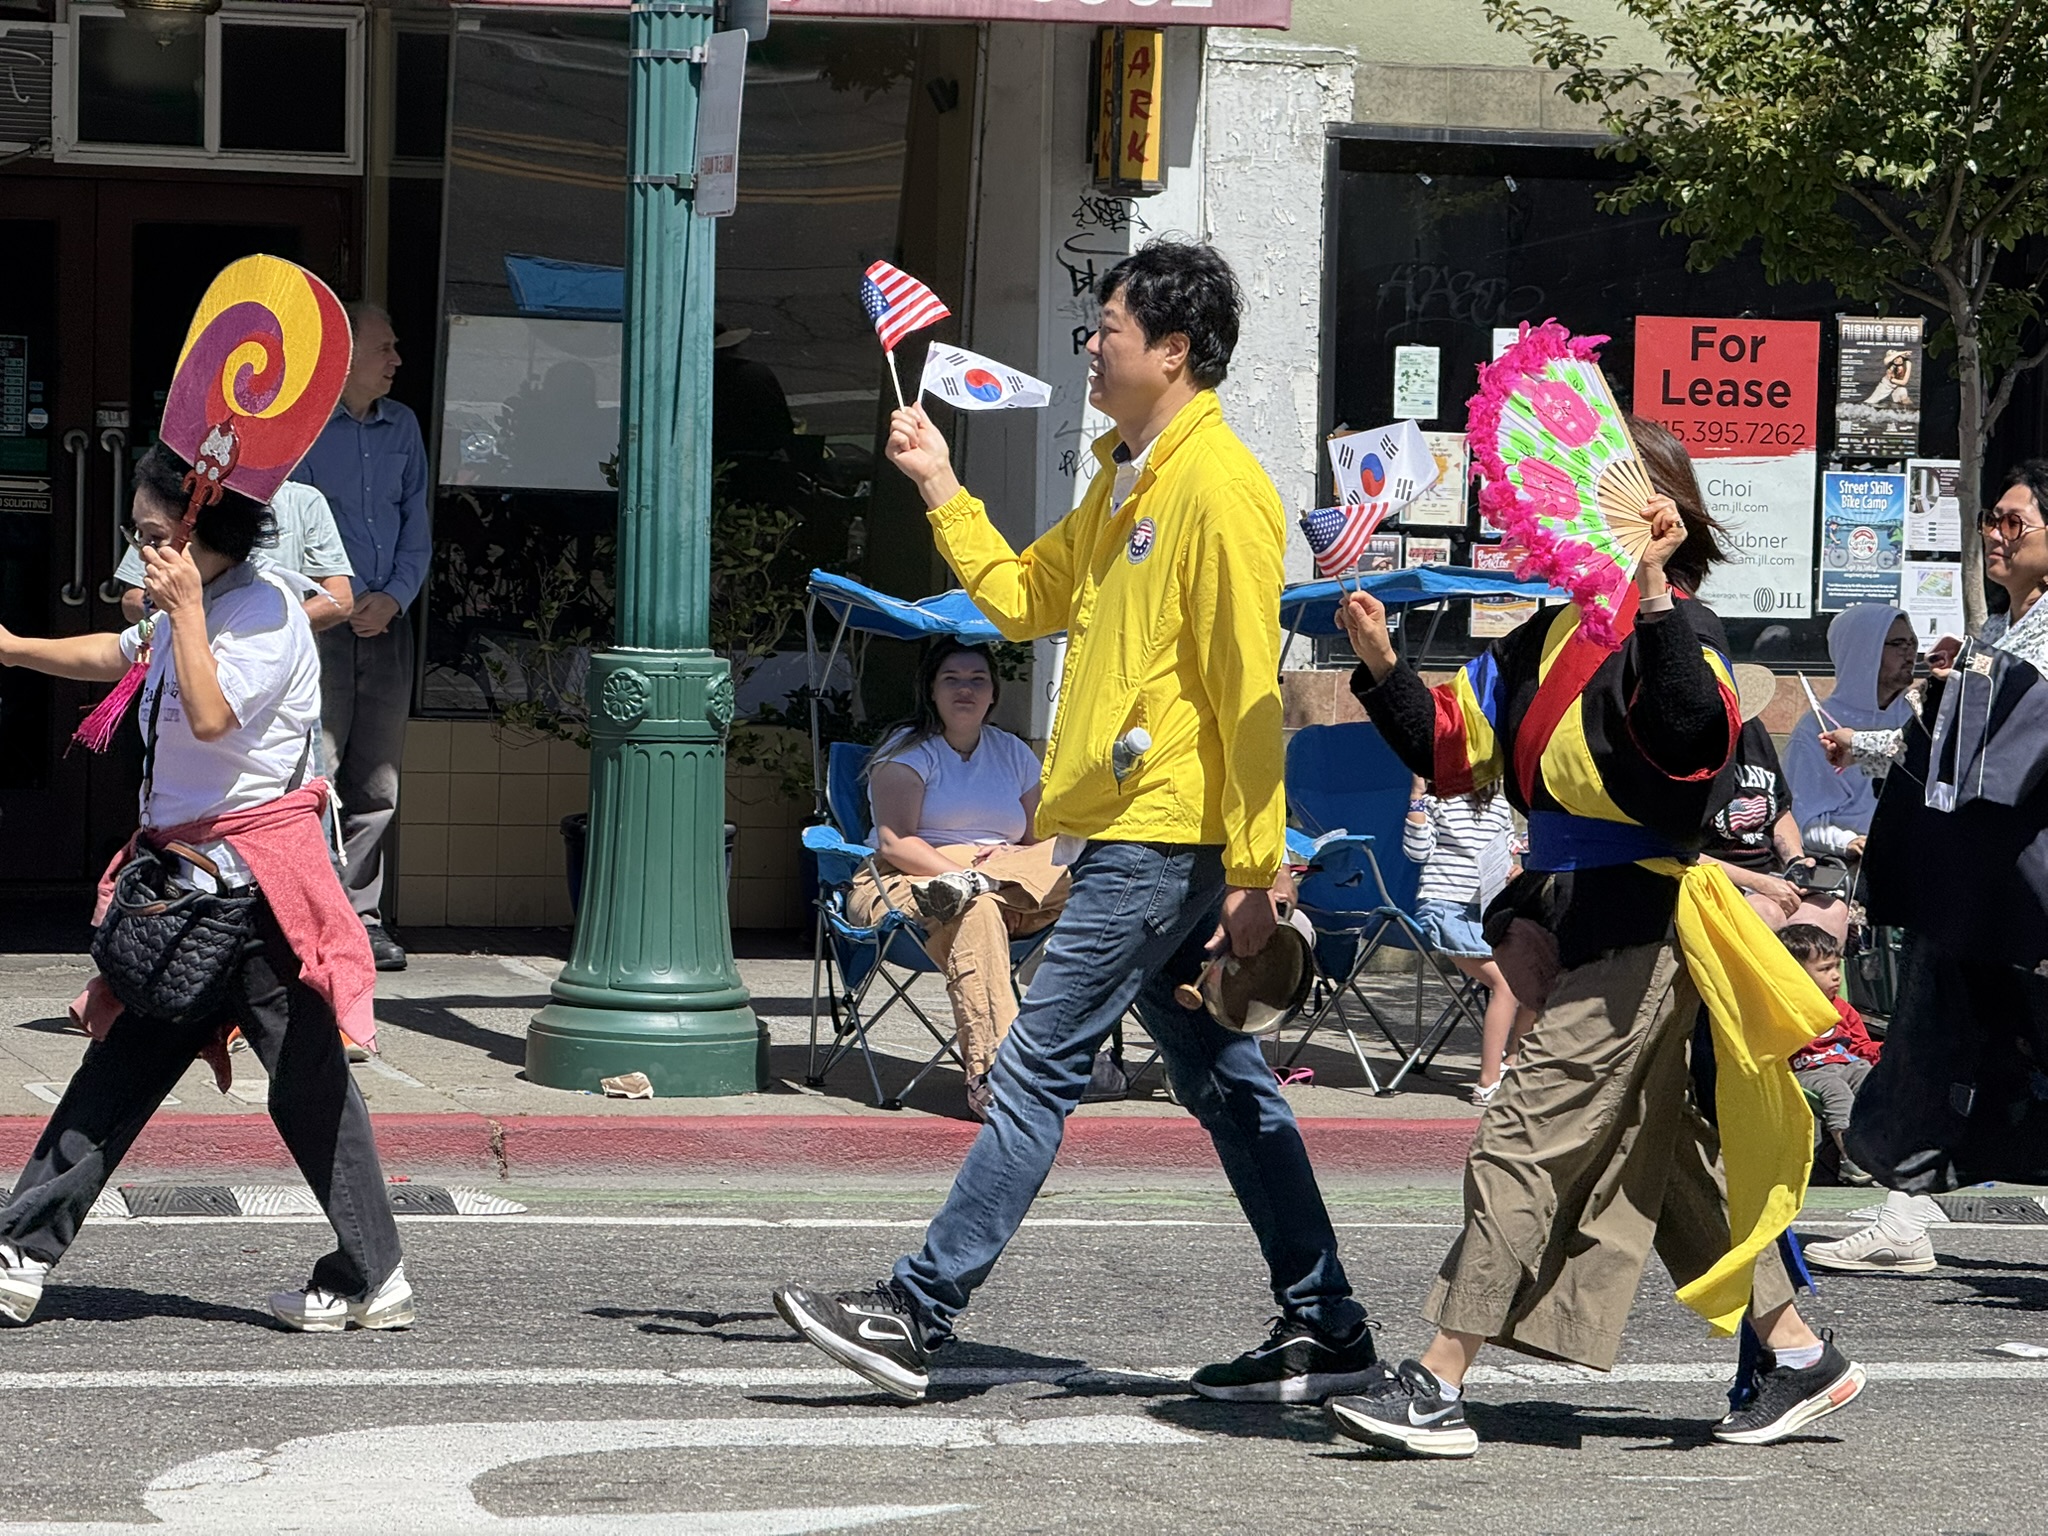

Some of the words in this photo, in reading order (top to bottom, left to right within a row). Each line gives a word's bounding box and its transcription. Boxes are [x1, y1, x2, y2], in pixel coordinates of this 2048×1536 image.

[1127, 46, 1152, 163] ARK
[1842, 324, 1884, 337] RISING
[1886, 325, 1919, 338] SEAS
[1691, 326, 1766, 363] For
[1662, 369, 1792, 408] Lease
[1707, 479, 1752, 497] Choi
[1839, 480, 1868, 494] Street
[1870, 481, 1893, 495] Skills
[3, 497, 47, 510] SOLICITING
[1841, 495, 1860, 508] Bike
[1862, 496, 1887, 511] Camp
[1776, 592, 1806, 609] JLL
